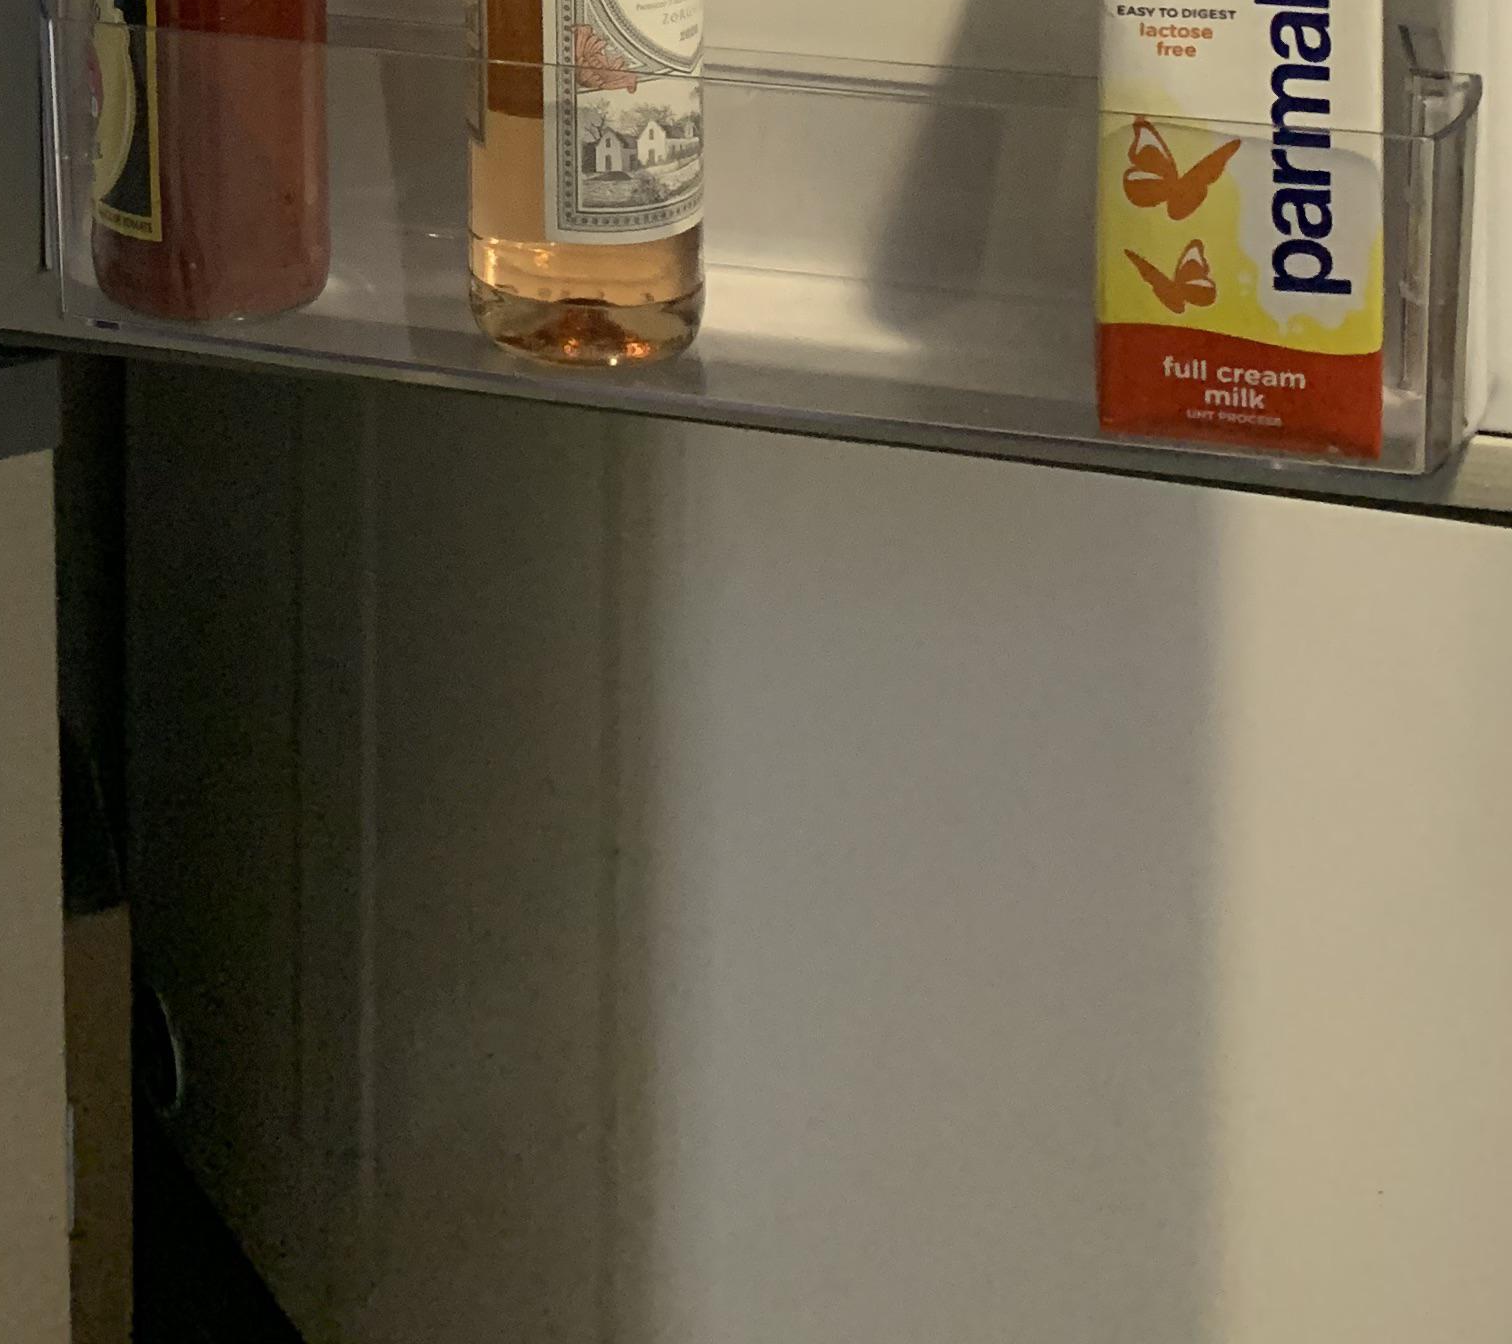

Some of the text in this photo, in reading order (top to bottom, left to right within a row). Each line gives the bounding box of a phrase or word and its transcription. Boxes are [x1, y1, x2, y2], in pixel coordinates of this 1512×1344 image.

[1117, 5, 1237, 20] EASY TO DIGEST
[1139, 22, 1213, 39] lactose
[1156, 41, 1197, 57] free
[1162, 355, 1306, 390] full cream
[1204, 387, 1265, 409] milk
